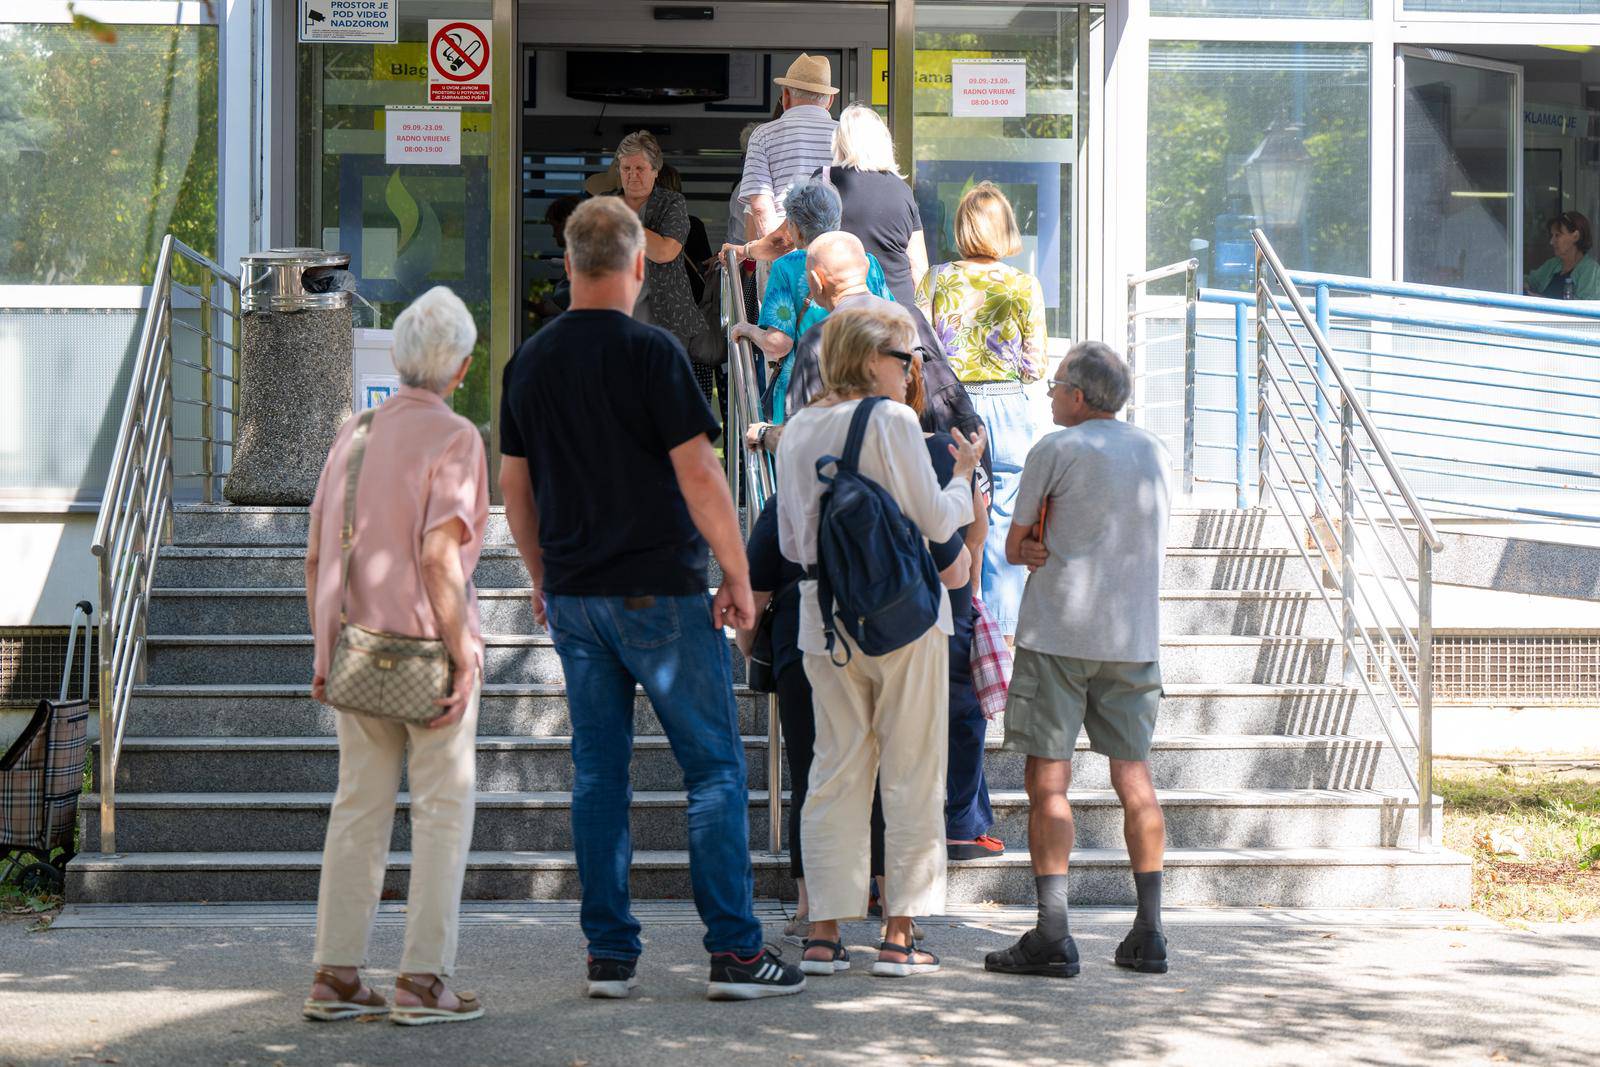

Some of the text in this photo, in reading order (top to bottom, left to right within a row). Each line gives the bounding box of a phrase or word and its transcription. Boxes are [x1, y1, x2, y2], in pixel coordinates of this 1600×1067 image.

[330, 1, 389, 9] PROSTOR JE
[332, 10, 387, 18] POD VIDEO
[330, 20, 389, 28] NADZOROM
